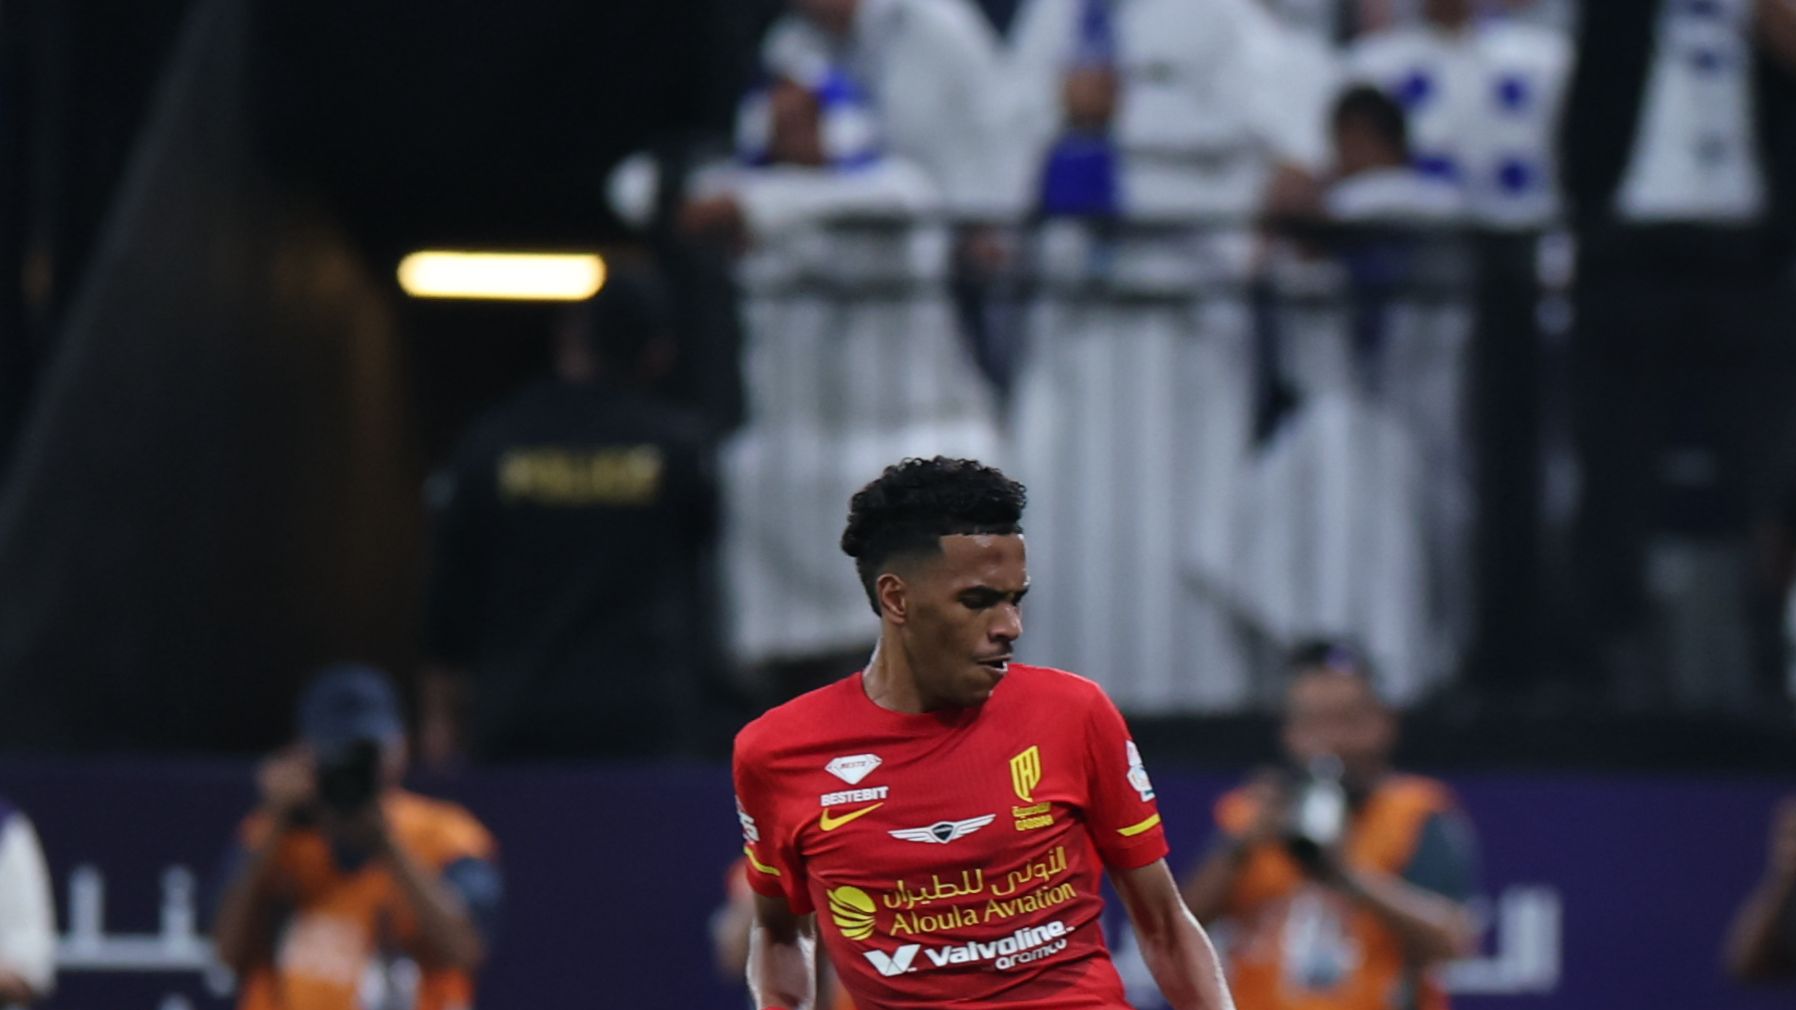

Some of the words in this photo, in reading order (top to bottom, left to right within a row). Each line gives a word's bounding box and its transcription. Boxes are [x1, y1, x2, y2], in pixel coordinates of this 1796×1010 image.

[820, 786, 889, 807] BESTEBIT
[889, 904, 980, 936] Aloula
[984, 882, 1077, 922] Aviation
[924, 920, 1067, 967] Valvoline
